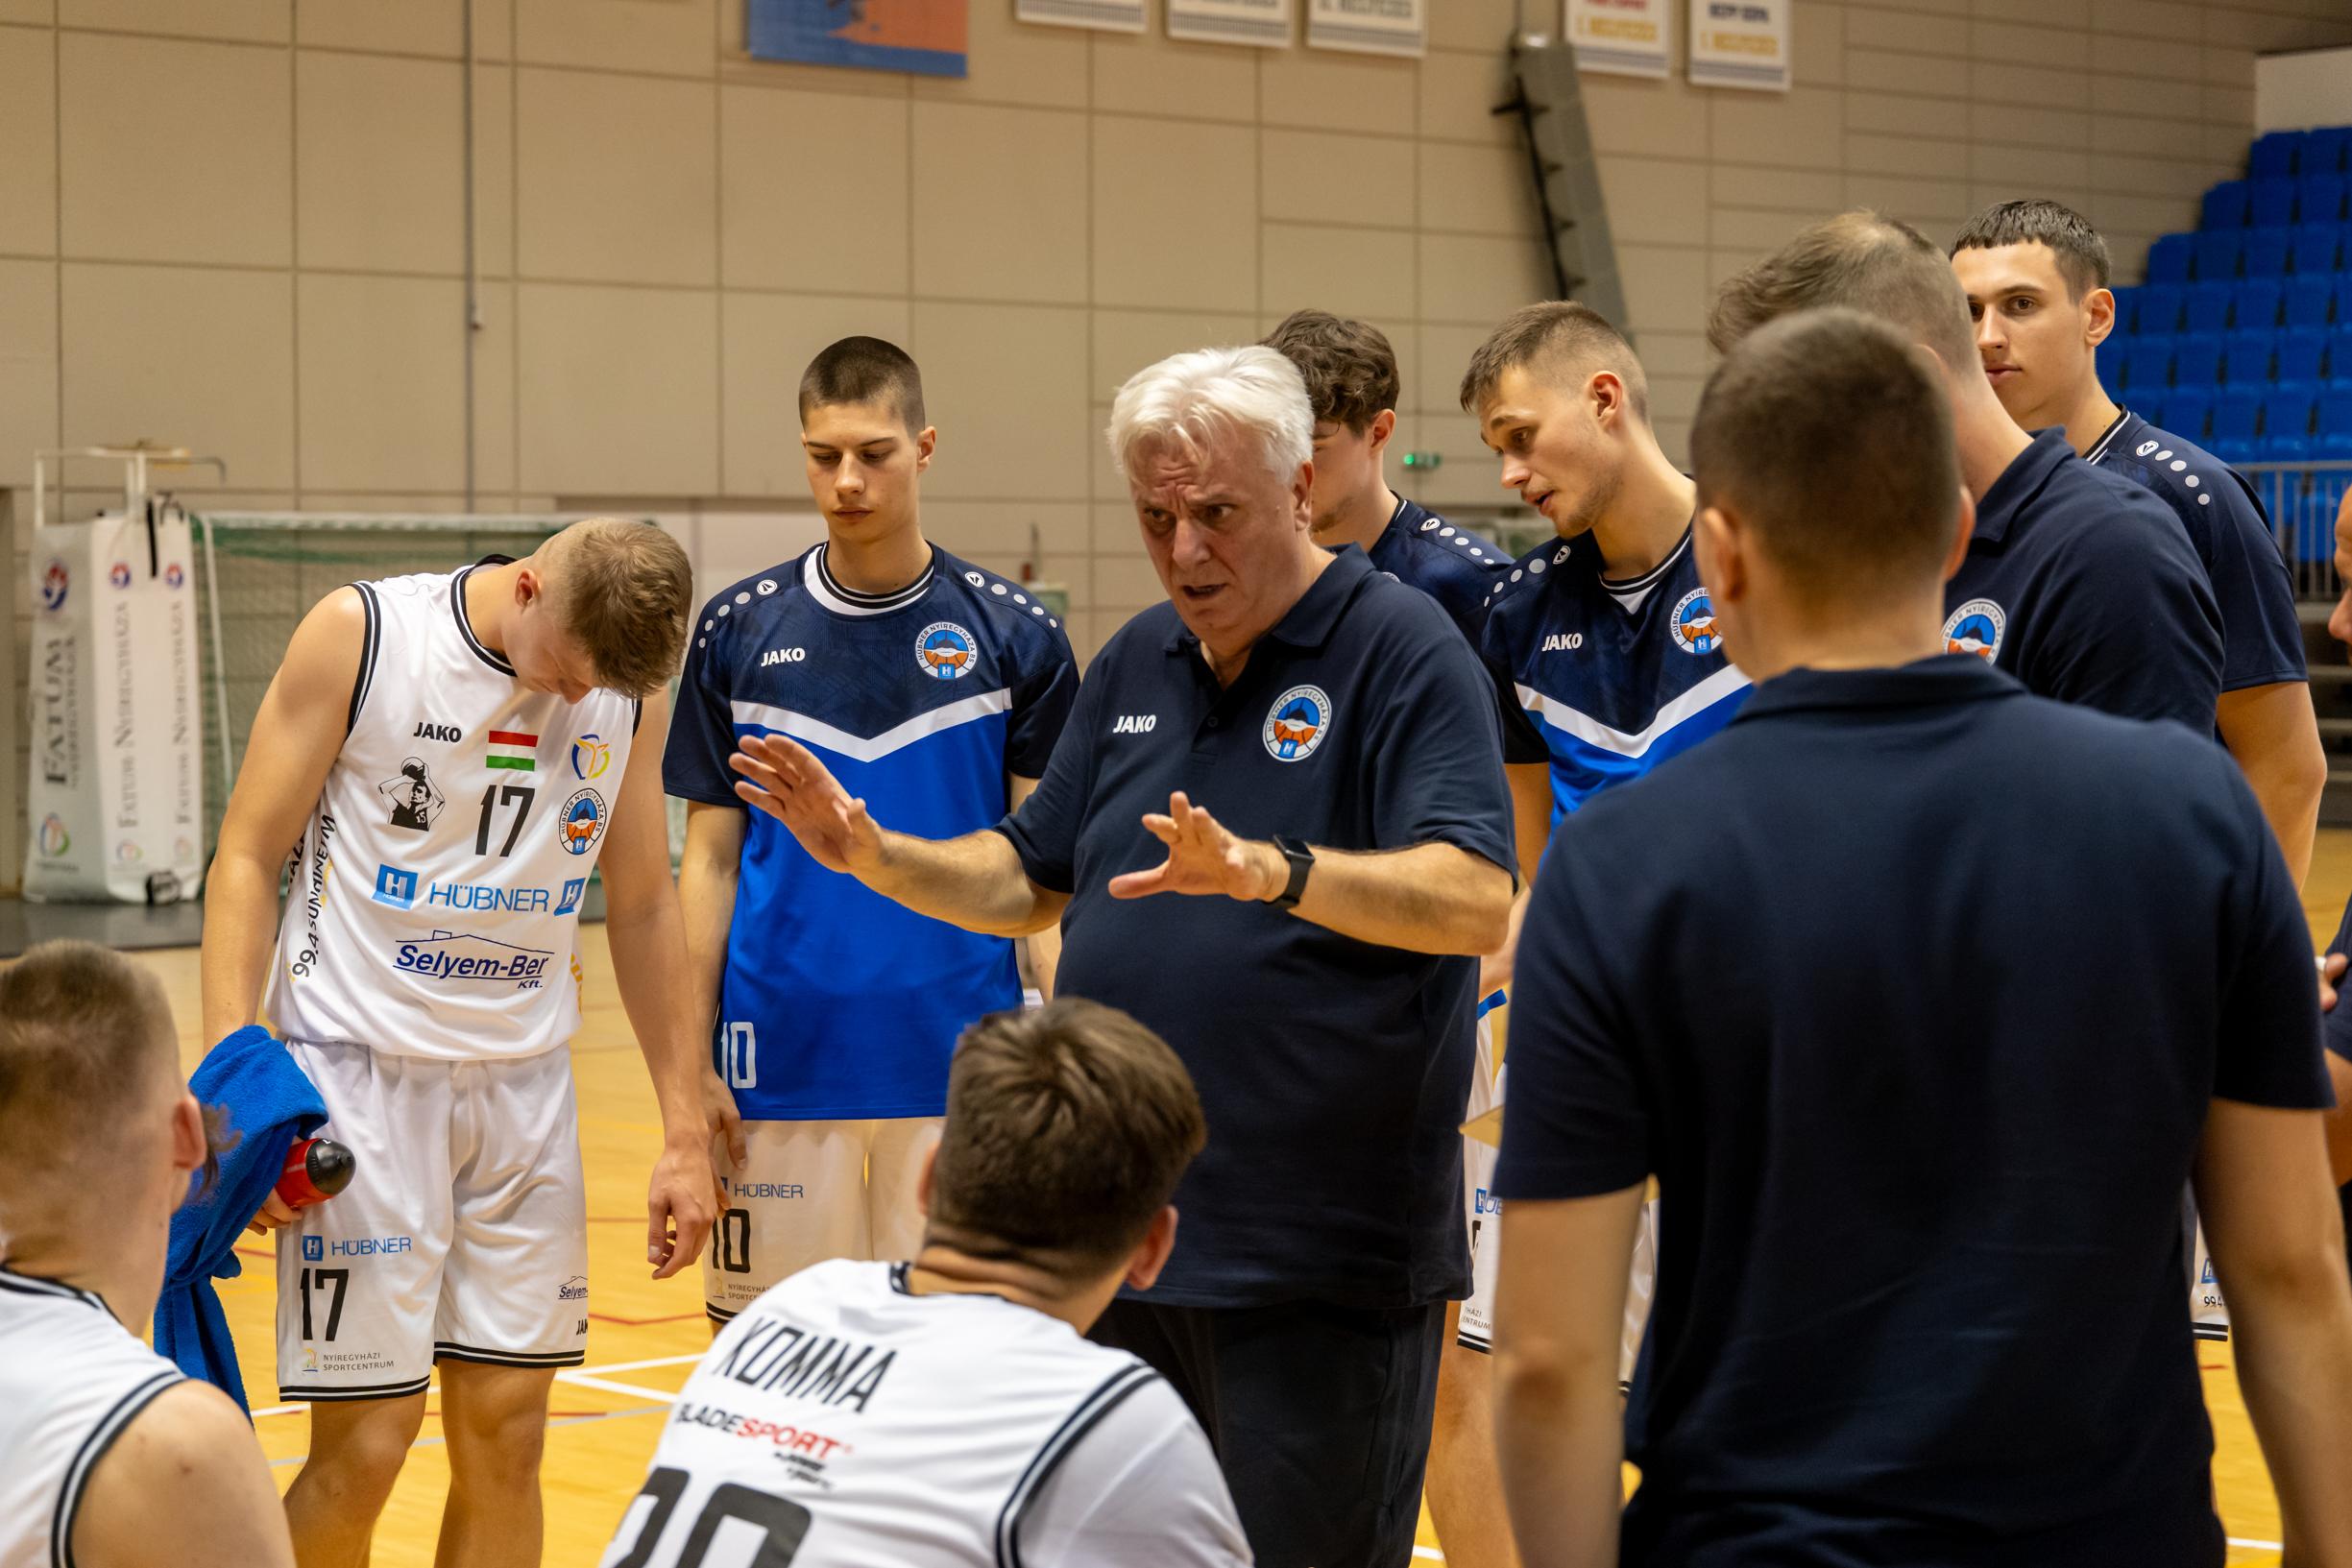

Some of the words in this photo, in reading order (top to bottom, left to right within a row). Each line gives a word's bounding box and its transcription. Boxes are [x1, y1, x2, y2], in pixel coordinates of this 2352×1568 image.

[1541, 633, 1583, 652] JAKO
[761, 647, 806, 667] JAKO
[44, 638, 67, 785] FATUM
[413, 722, 462, 743] JAKO
[1112, 714, 1156, 734] JAKO
[416, 811, 426, 823] 15
[475, 784, 536, 857] 17
[429, 882, 549, 912] HÜBNER
[292, 932, 320, 977] 99.4
[397, 944, 549, 979] Selyem-Ber
[518, 980, 544, 990] Kft.
[720, 1022, 757, 1089] 10
[734, 1183, 804, 1198] HÜBNER
[331, 1237, 411, 1256] HÜBNER
[300, 1268, 350, 1341] 17
[323, 1352, 380, 1362] NYÍREGYHÁZI
[323, 1360, 395, 1371] SPORTCENTRUM
[713, 1316, 898, 1414] KOMMA
